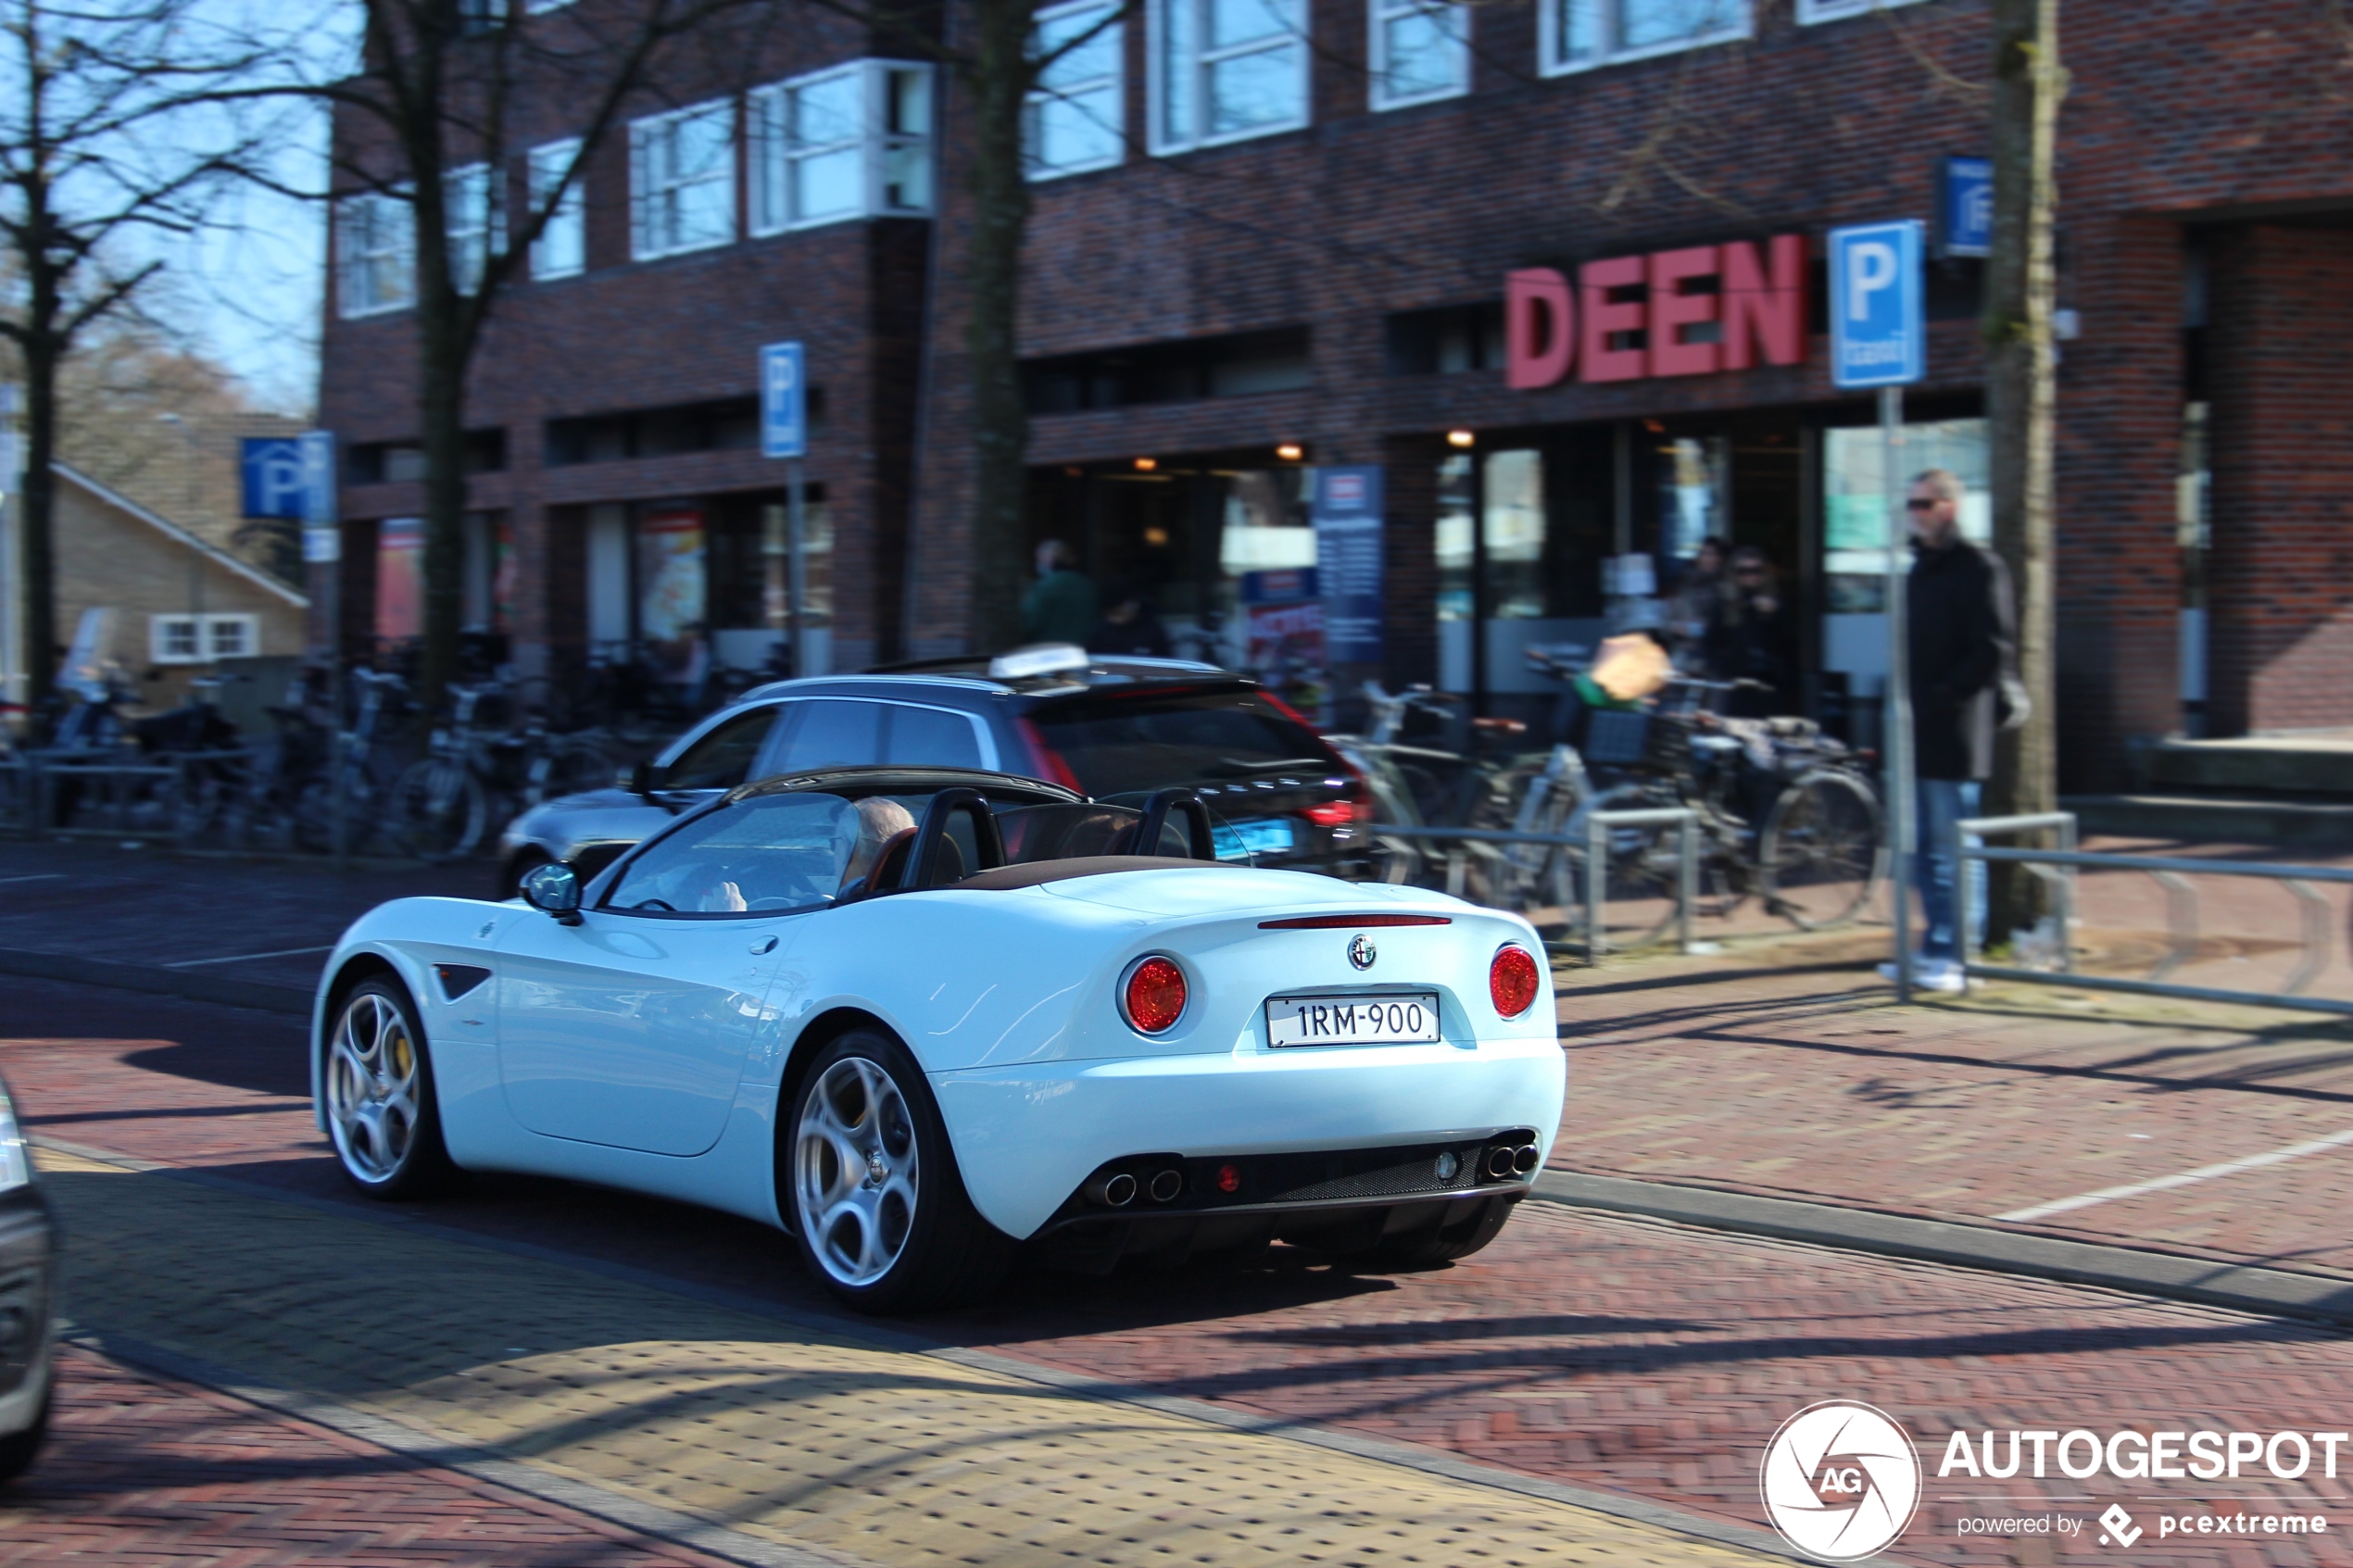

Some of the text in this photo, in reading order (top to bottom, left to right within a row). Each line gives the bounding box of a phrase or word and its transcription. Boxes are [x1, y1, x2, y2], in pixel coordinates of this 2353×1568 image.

[1504, 233, 1809, 390] DEEN
[1848, 243, 1897, 321] P
[768, 356, 797, 412] P
[1298, 1003, 1422, 1036] 1RM-900
